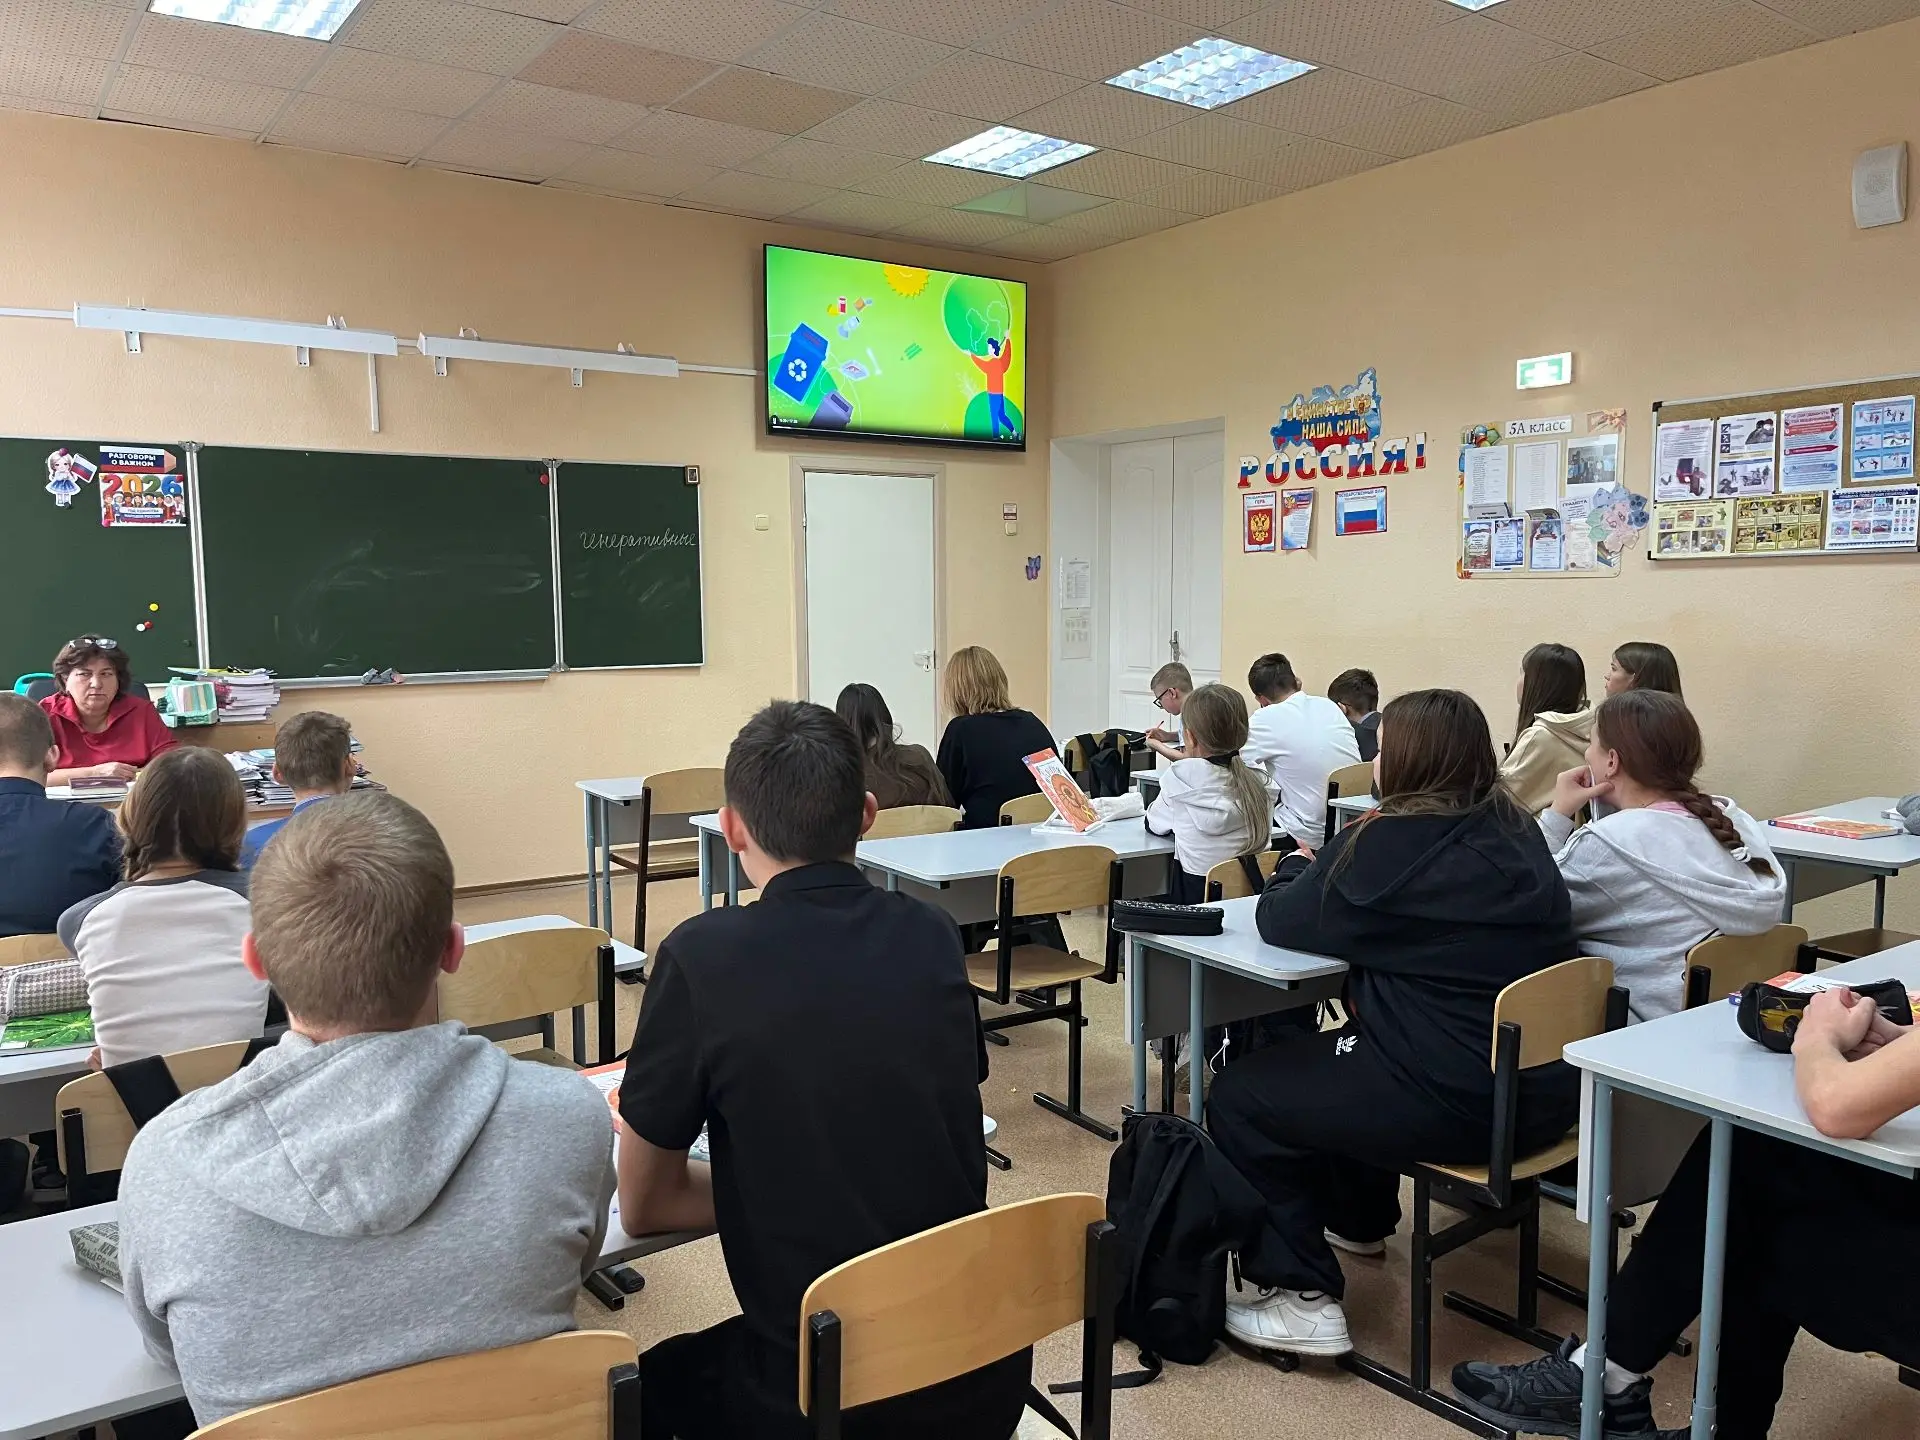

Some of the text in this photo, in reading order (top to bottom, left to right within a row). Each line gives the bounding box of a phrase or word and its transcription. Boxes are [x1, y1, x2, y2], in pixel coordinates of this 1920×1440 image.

[1302, 418, 1367, 439] НАША СИЛА
[1508, 420, 1566, 436] 5А класс
[108, 452, 156, 461] РАЗГОВОРЫ
[102, 473, 183, 498] 2026
